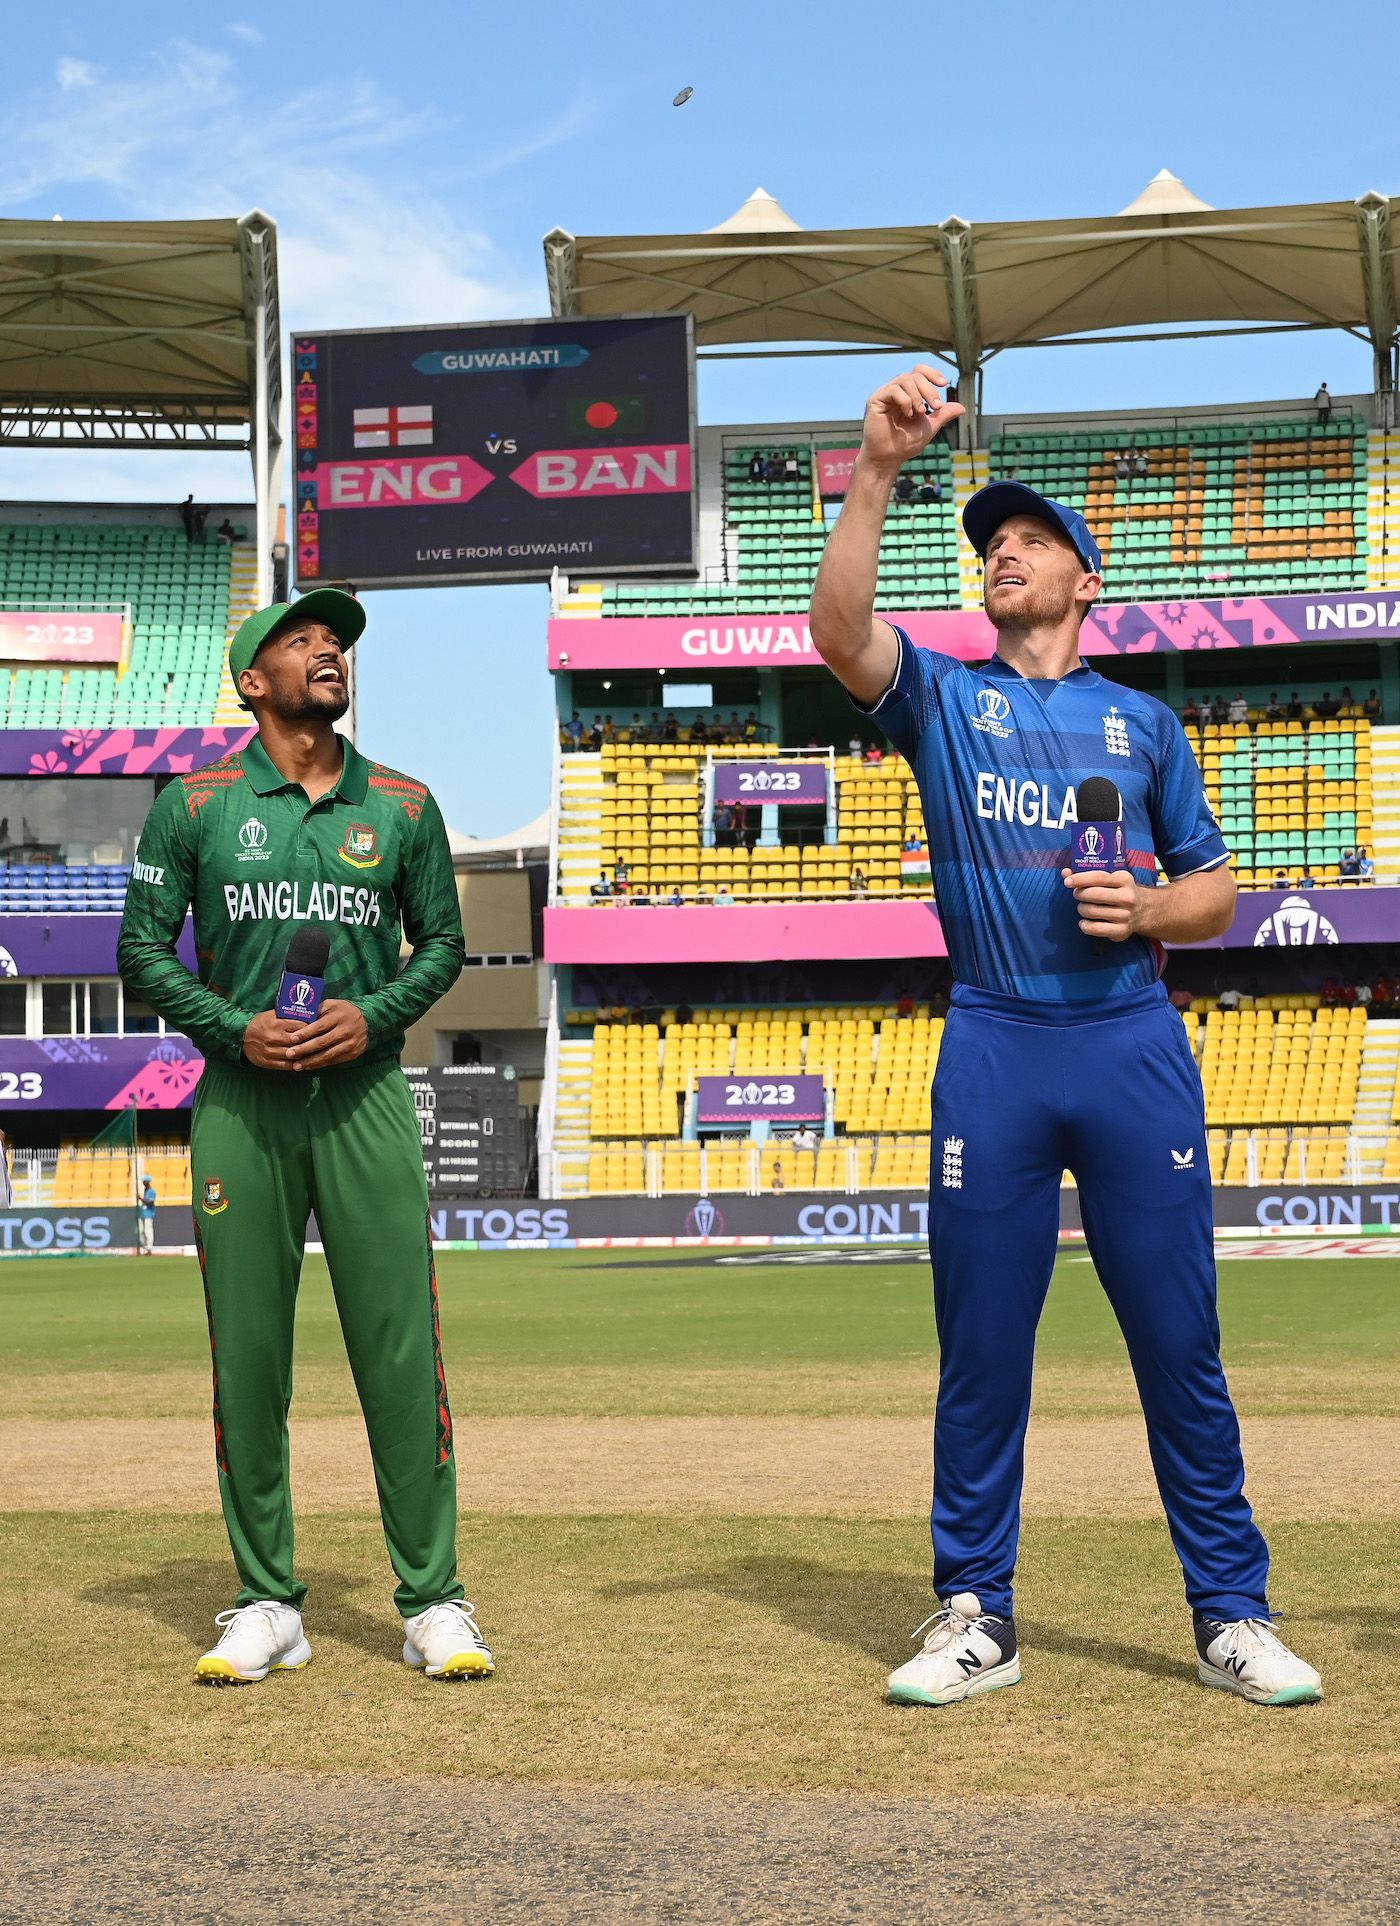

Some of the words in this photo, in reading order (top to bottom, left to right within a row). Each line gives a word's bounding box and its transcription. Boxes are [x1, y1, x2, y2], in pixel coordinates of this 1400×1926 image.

[441, 349, 560, 371] GUWAHATI
[330, 461, 462, 504] ENG
[536, 450, 678, 493] BAN
[416, 548, 452, 561] LIVE
[456, 545, 503, 559] FROM
[508, 541, 593, 556] GUWAHATI
[1305, 601, 1400, 631] INDIA
[977, 771, 1122, 829] ENGLA
[223, 880, 381, 927] BANGLADESH
[442, 1066, 496, 1075] ASSOCIATION
[439, 1139, 480, 1148] SCORE
[455, 1209, 569, 1240] TOSS
[798, 1203, 900, 1235] COIN
[1256, 1195, 1362, 1226] COIN
[0, 1216, 111, 1249] TOSS
